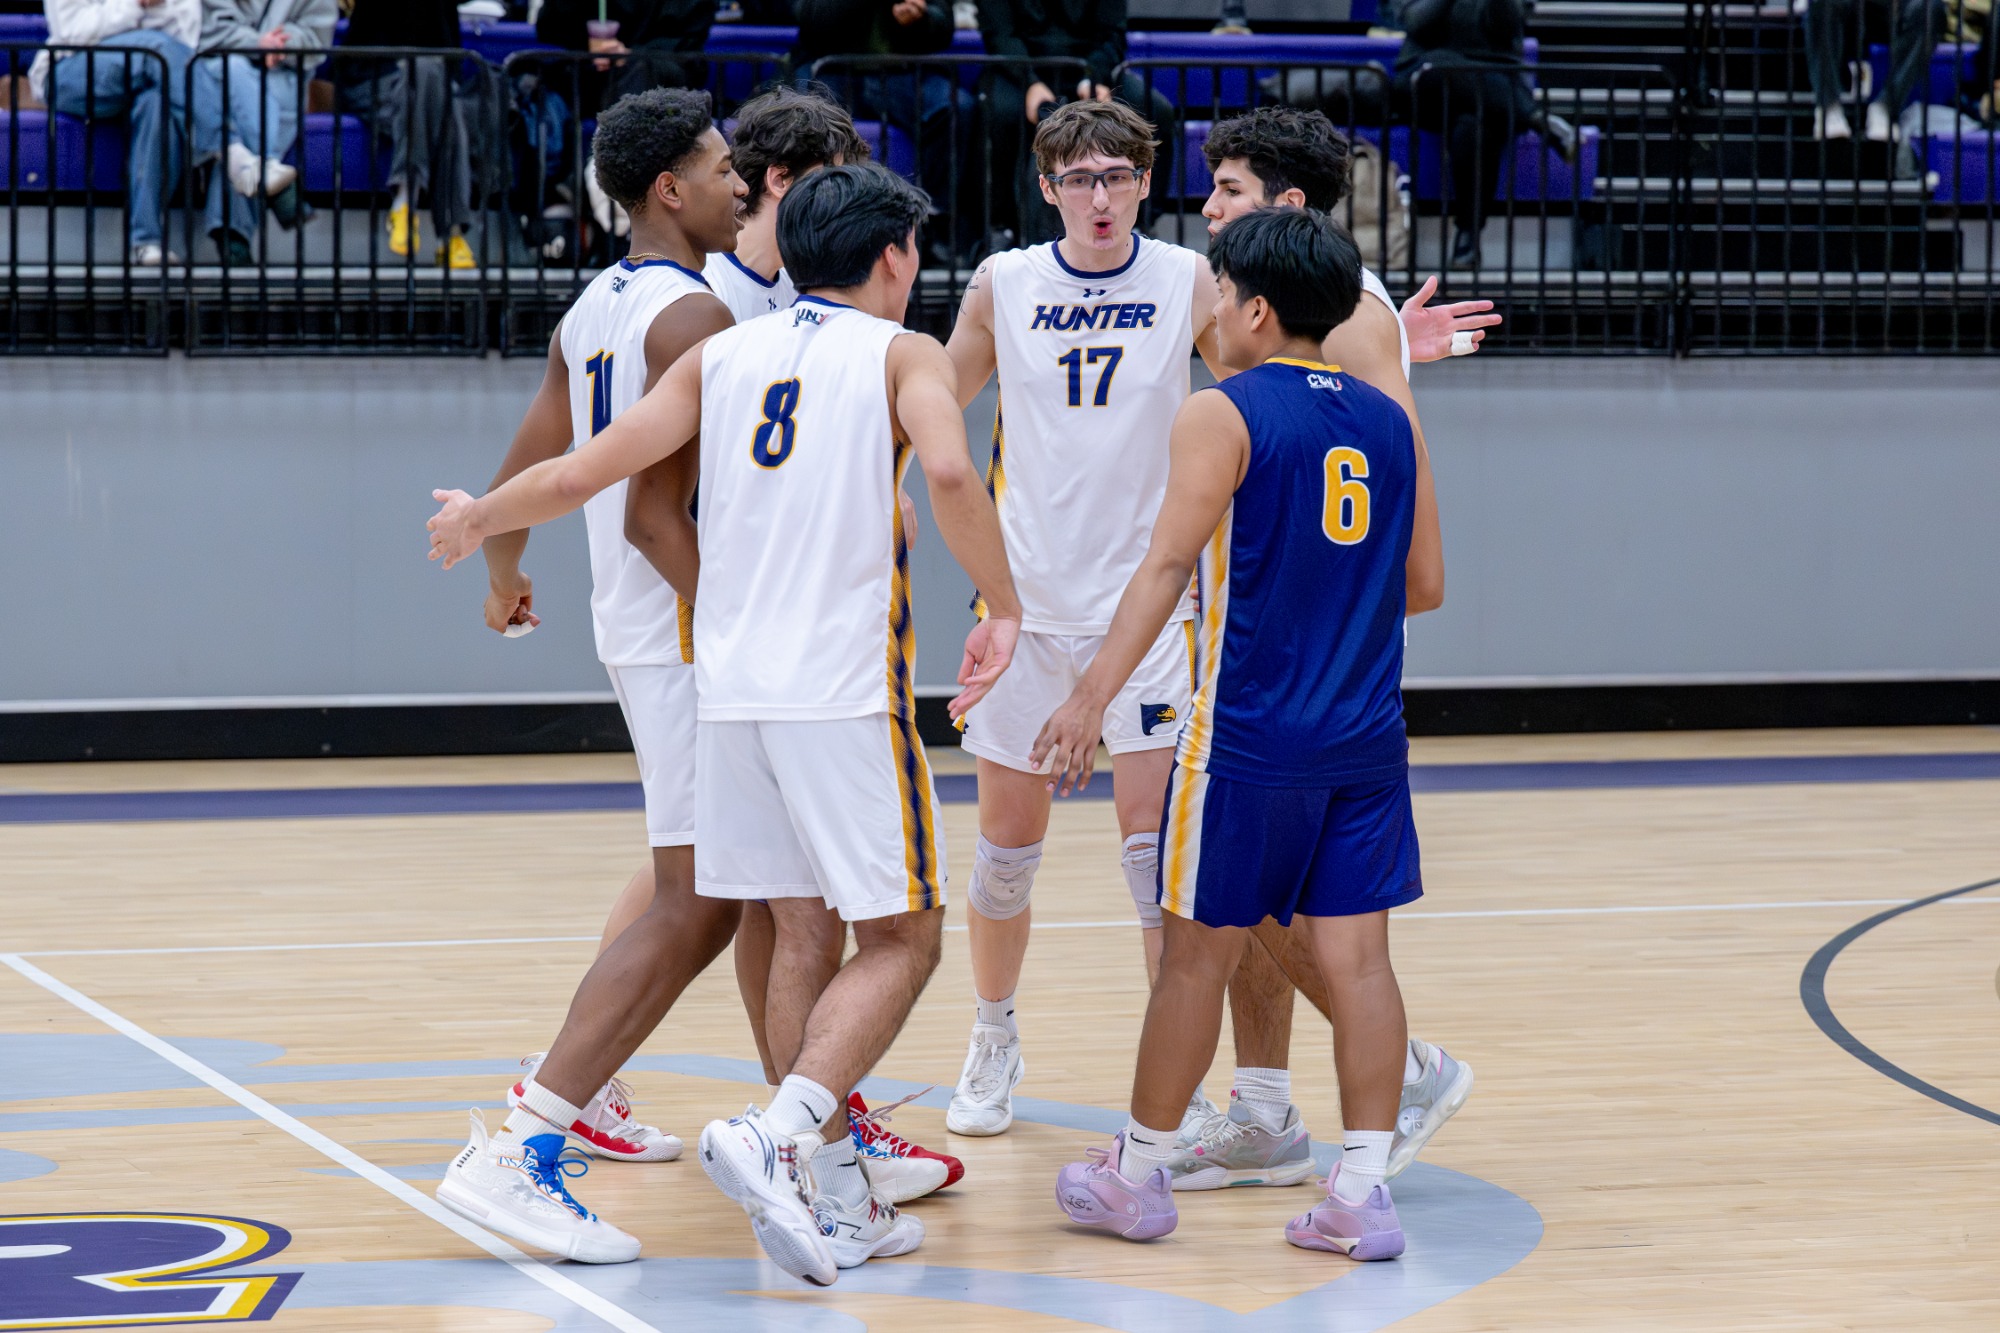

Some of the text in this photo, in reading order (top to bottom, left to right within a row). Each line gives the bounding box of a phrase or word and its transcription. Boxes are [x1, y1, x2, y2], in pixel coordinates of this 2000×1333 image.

[1029, 302, 1157, 332] HUNTER
[1058, 346, 1124, 407] 17
[750, 376, 802, 470] 8
[1322, 446, 1370, 545] 6
